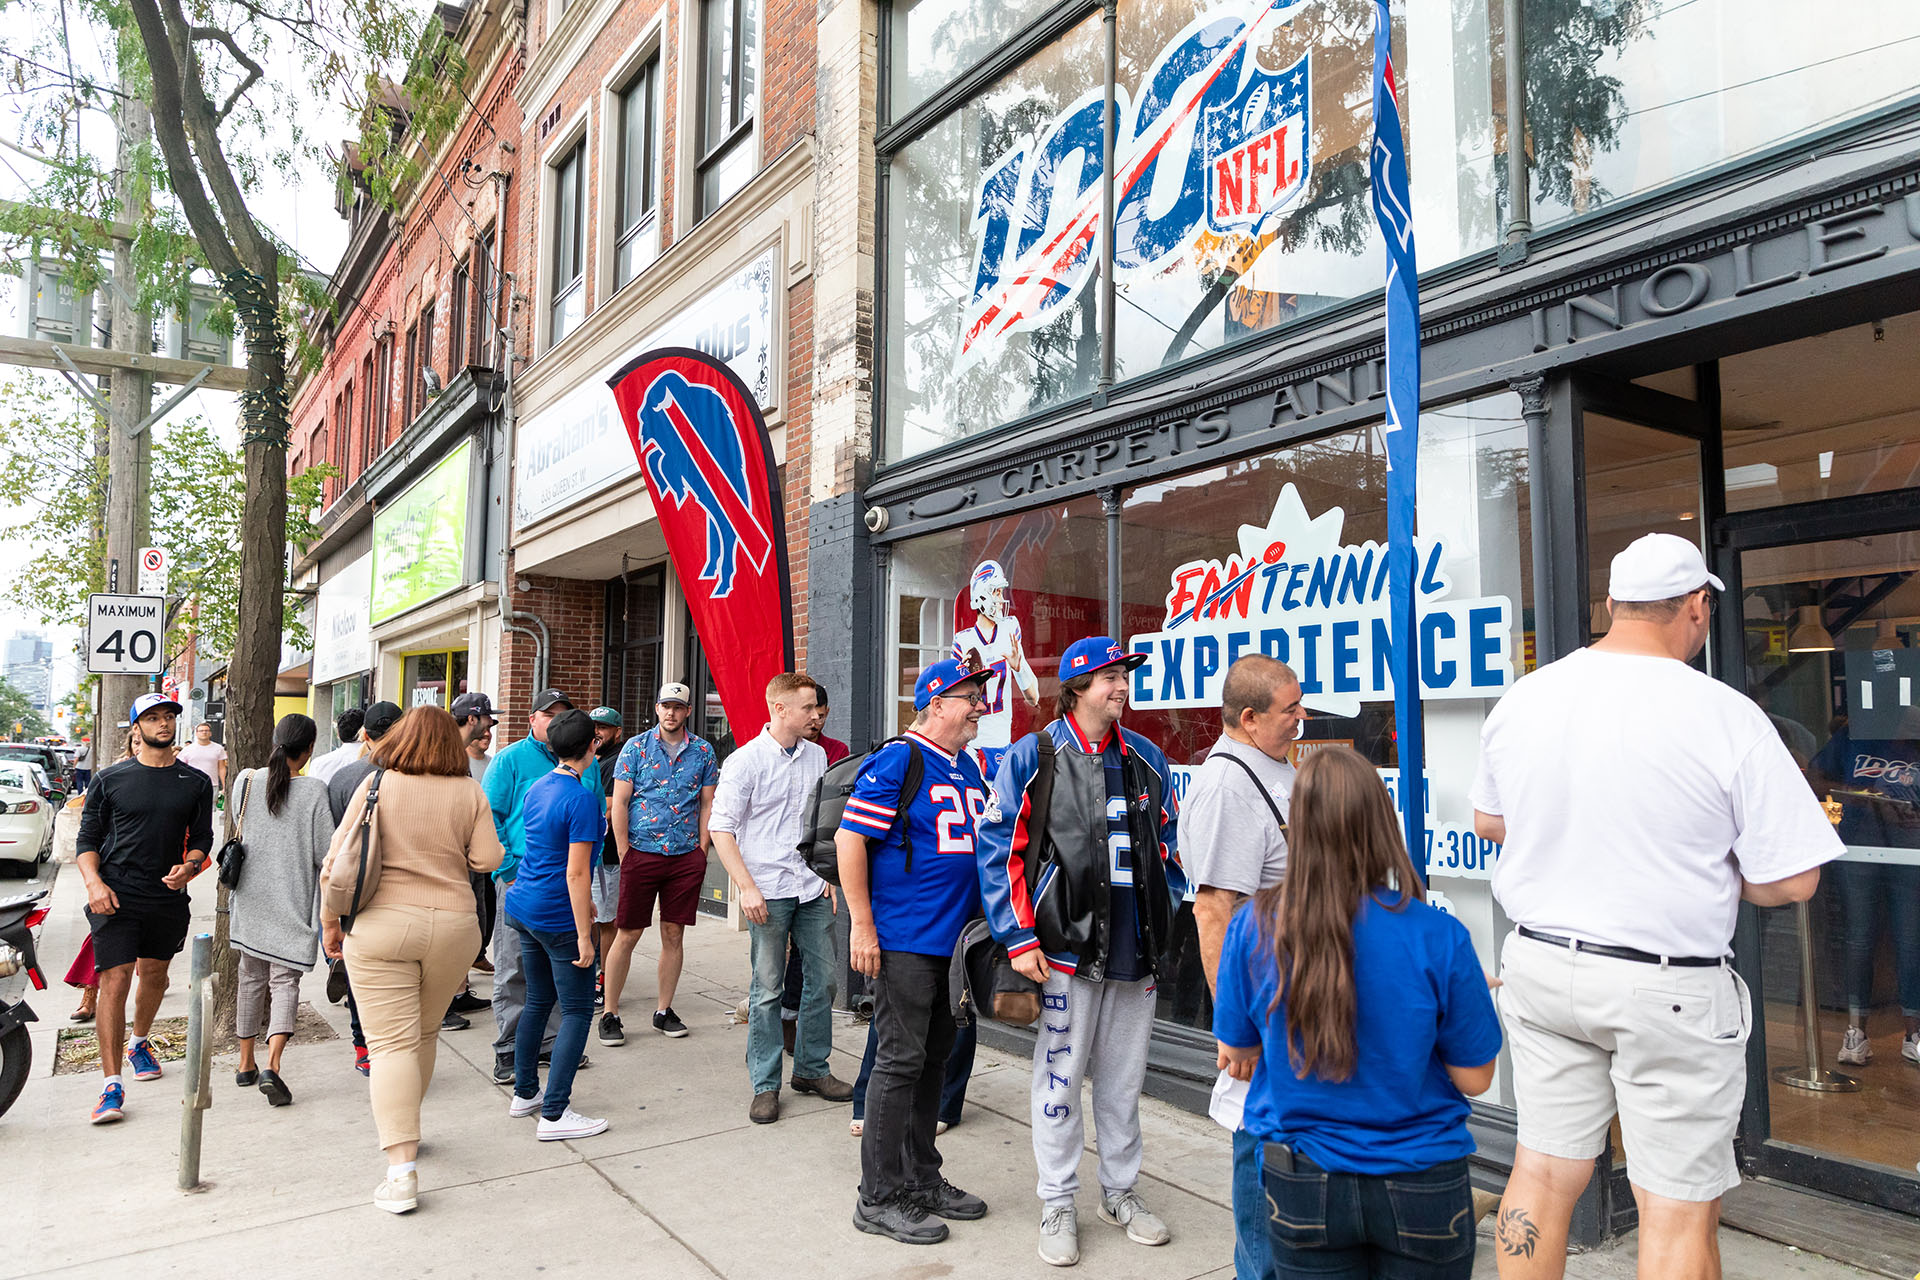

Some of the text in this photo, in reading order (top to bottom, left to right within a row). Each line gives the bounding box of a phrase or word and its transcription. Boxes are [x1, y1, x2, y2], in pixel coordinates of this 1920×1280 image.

[1216, 126, 1299, 218] NFL
[527, 402, 608, 480] Abraham's
[1000, 406, 1231, 498] CARPETS
[97, 604, 156, 618] MAXIMUM
[1167, 542, 1444, 622] FANTENNIL
[96, 629, 156, 663] 40
[1042, 992, 1071, 1119] BILLS
